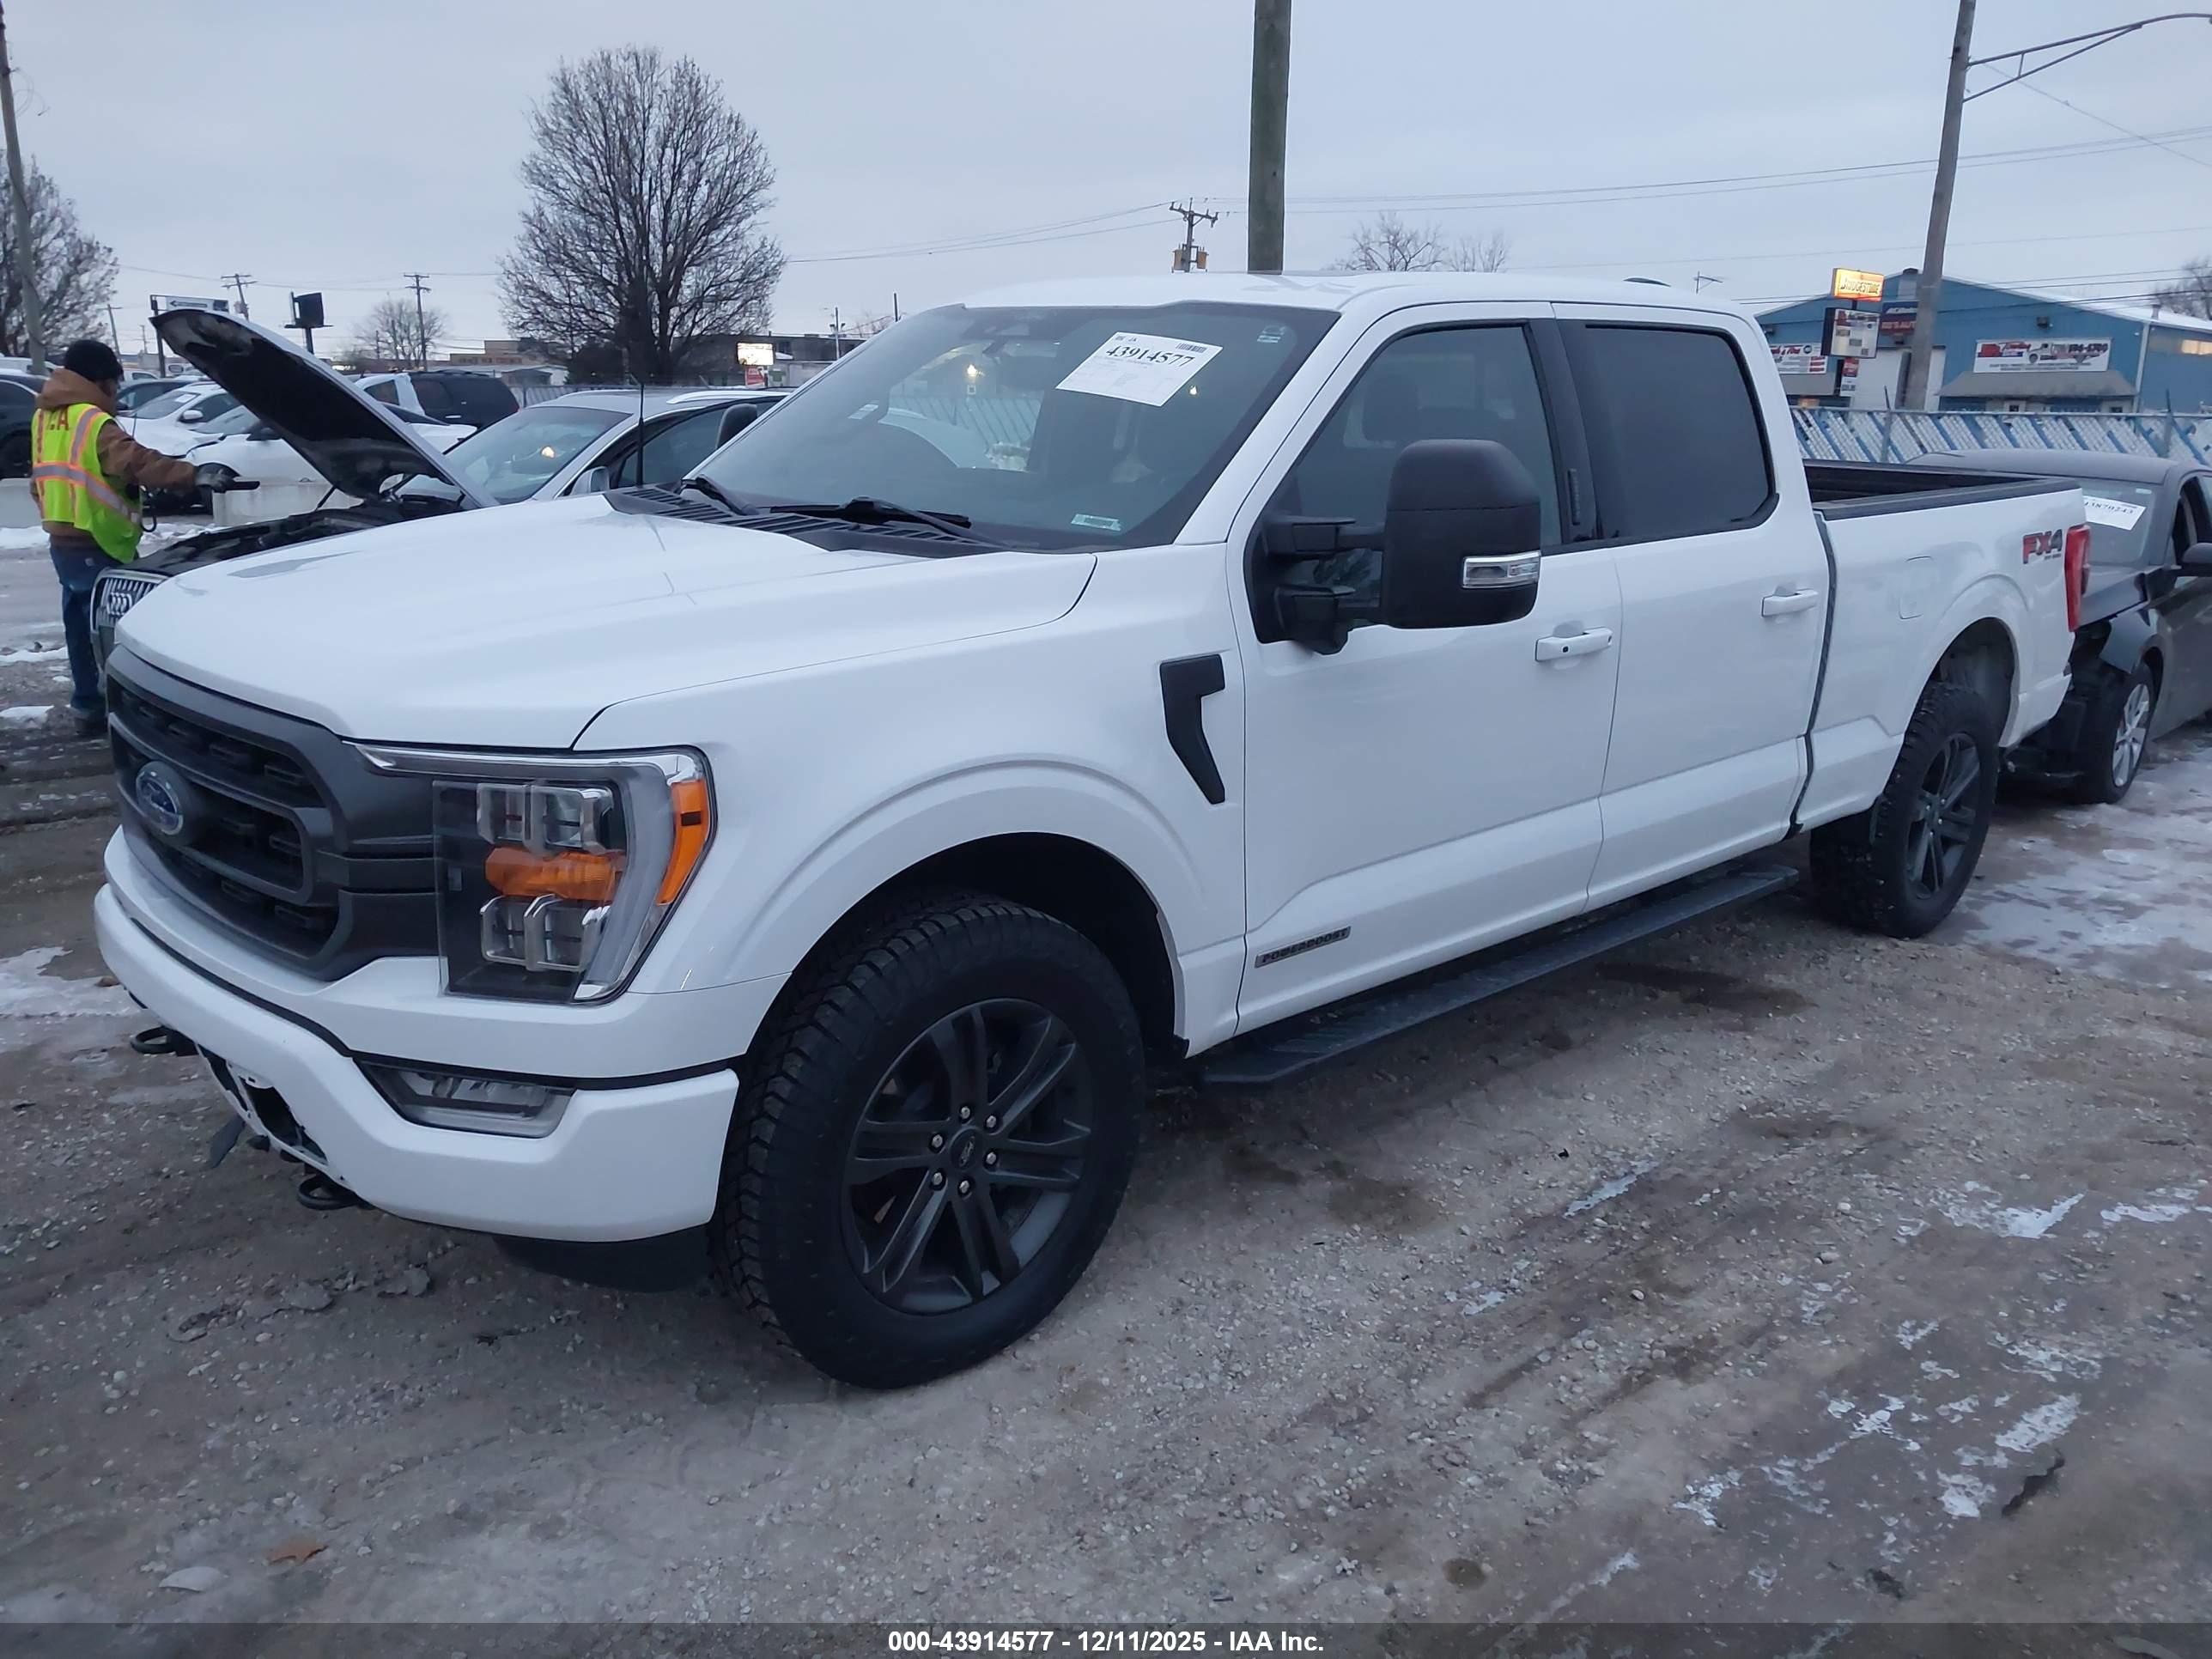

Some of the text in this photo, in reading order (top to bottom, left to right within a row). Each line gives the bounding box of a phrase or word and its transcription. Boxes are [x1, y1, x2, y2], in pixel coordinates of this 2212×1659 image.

[1106, 346, 1195, 367] 43914577
[2023, 528, 2063, 564] FX4
[1262, 927, 1348, 963] POWERBOOST
